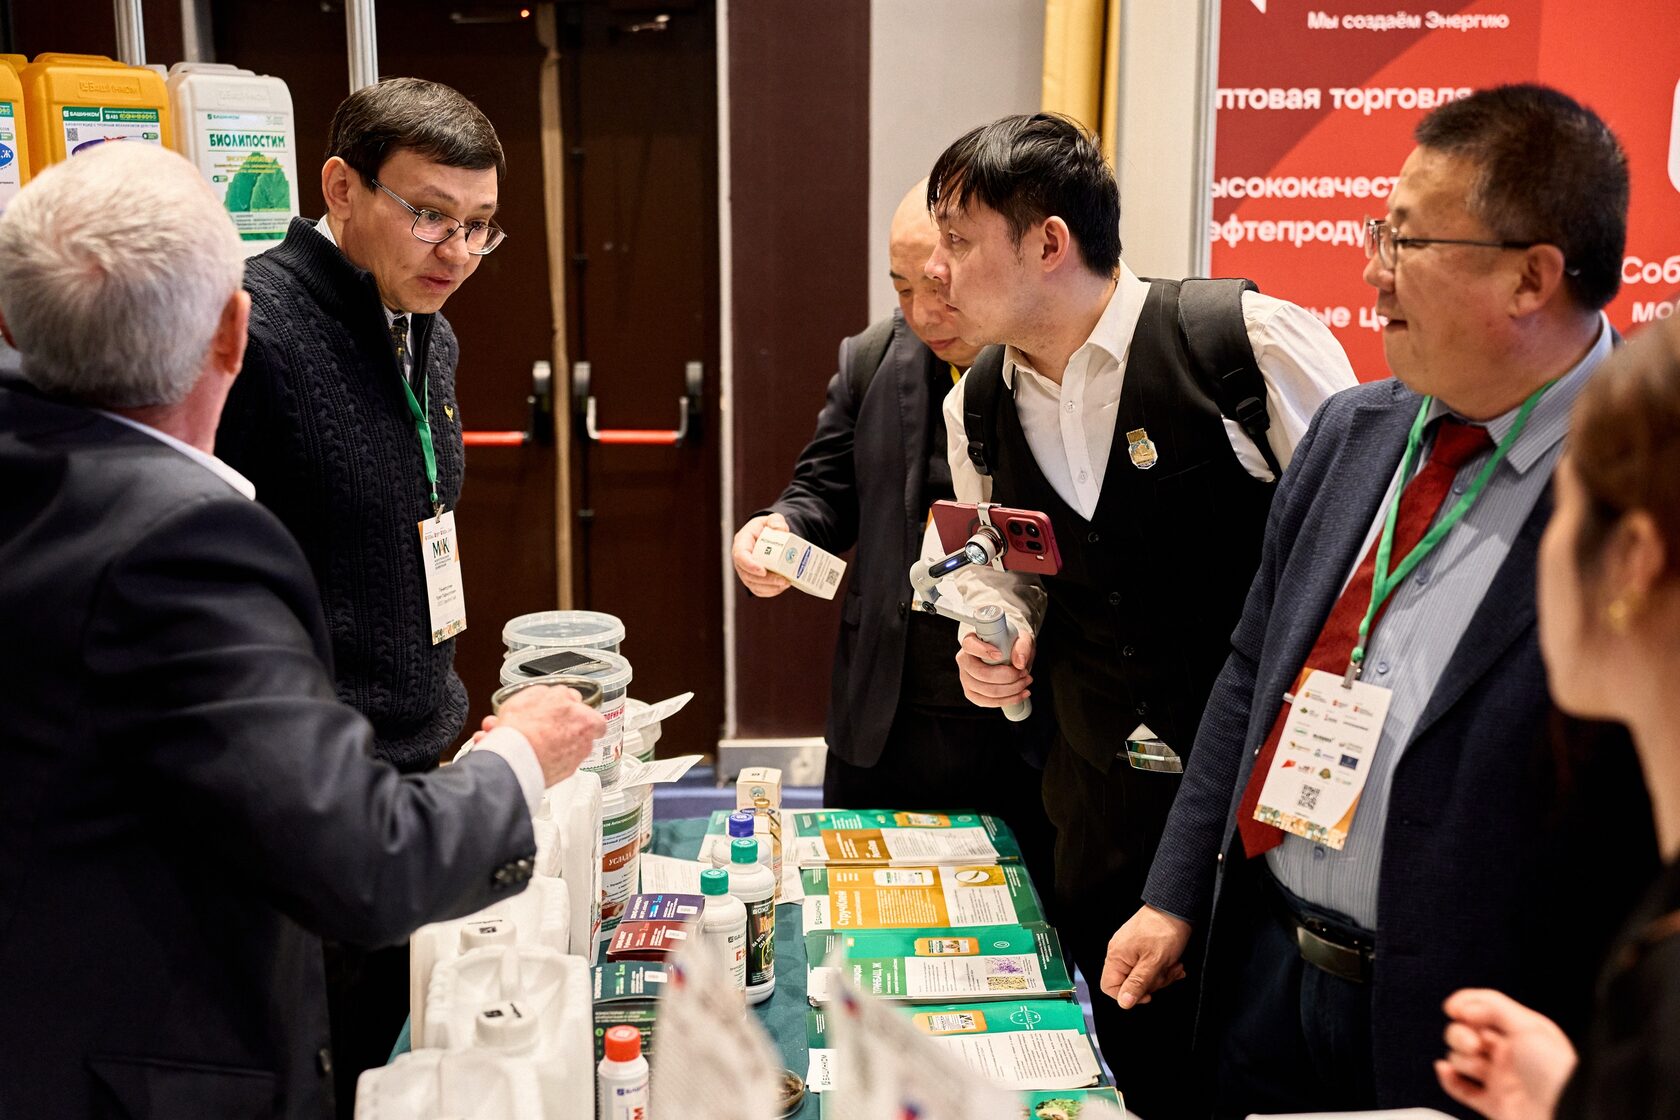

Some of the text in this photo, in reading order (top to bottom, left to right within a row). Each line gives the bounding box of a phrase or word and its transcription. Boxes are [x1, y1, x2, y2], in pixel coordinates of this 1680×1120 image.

[1308, 11, 1510, 32] Мы создаём Энергию
[209, 133, 286, 148] БИОЛИПОСТИМ
